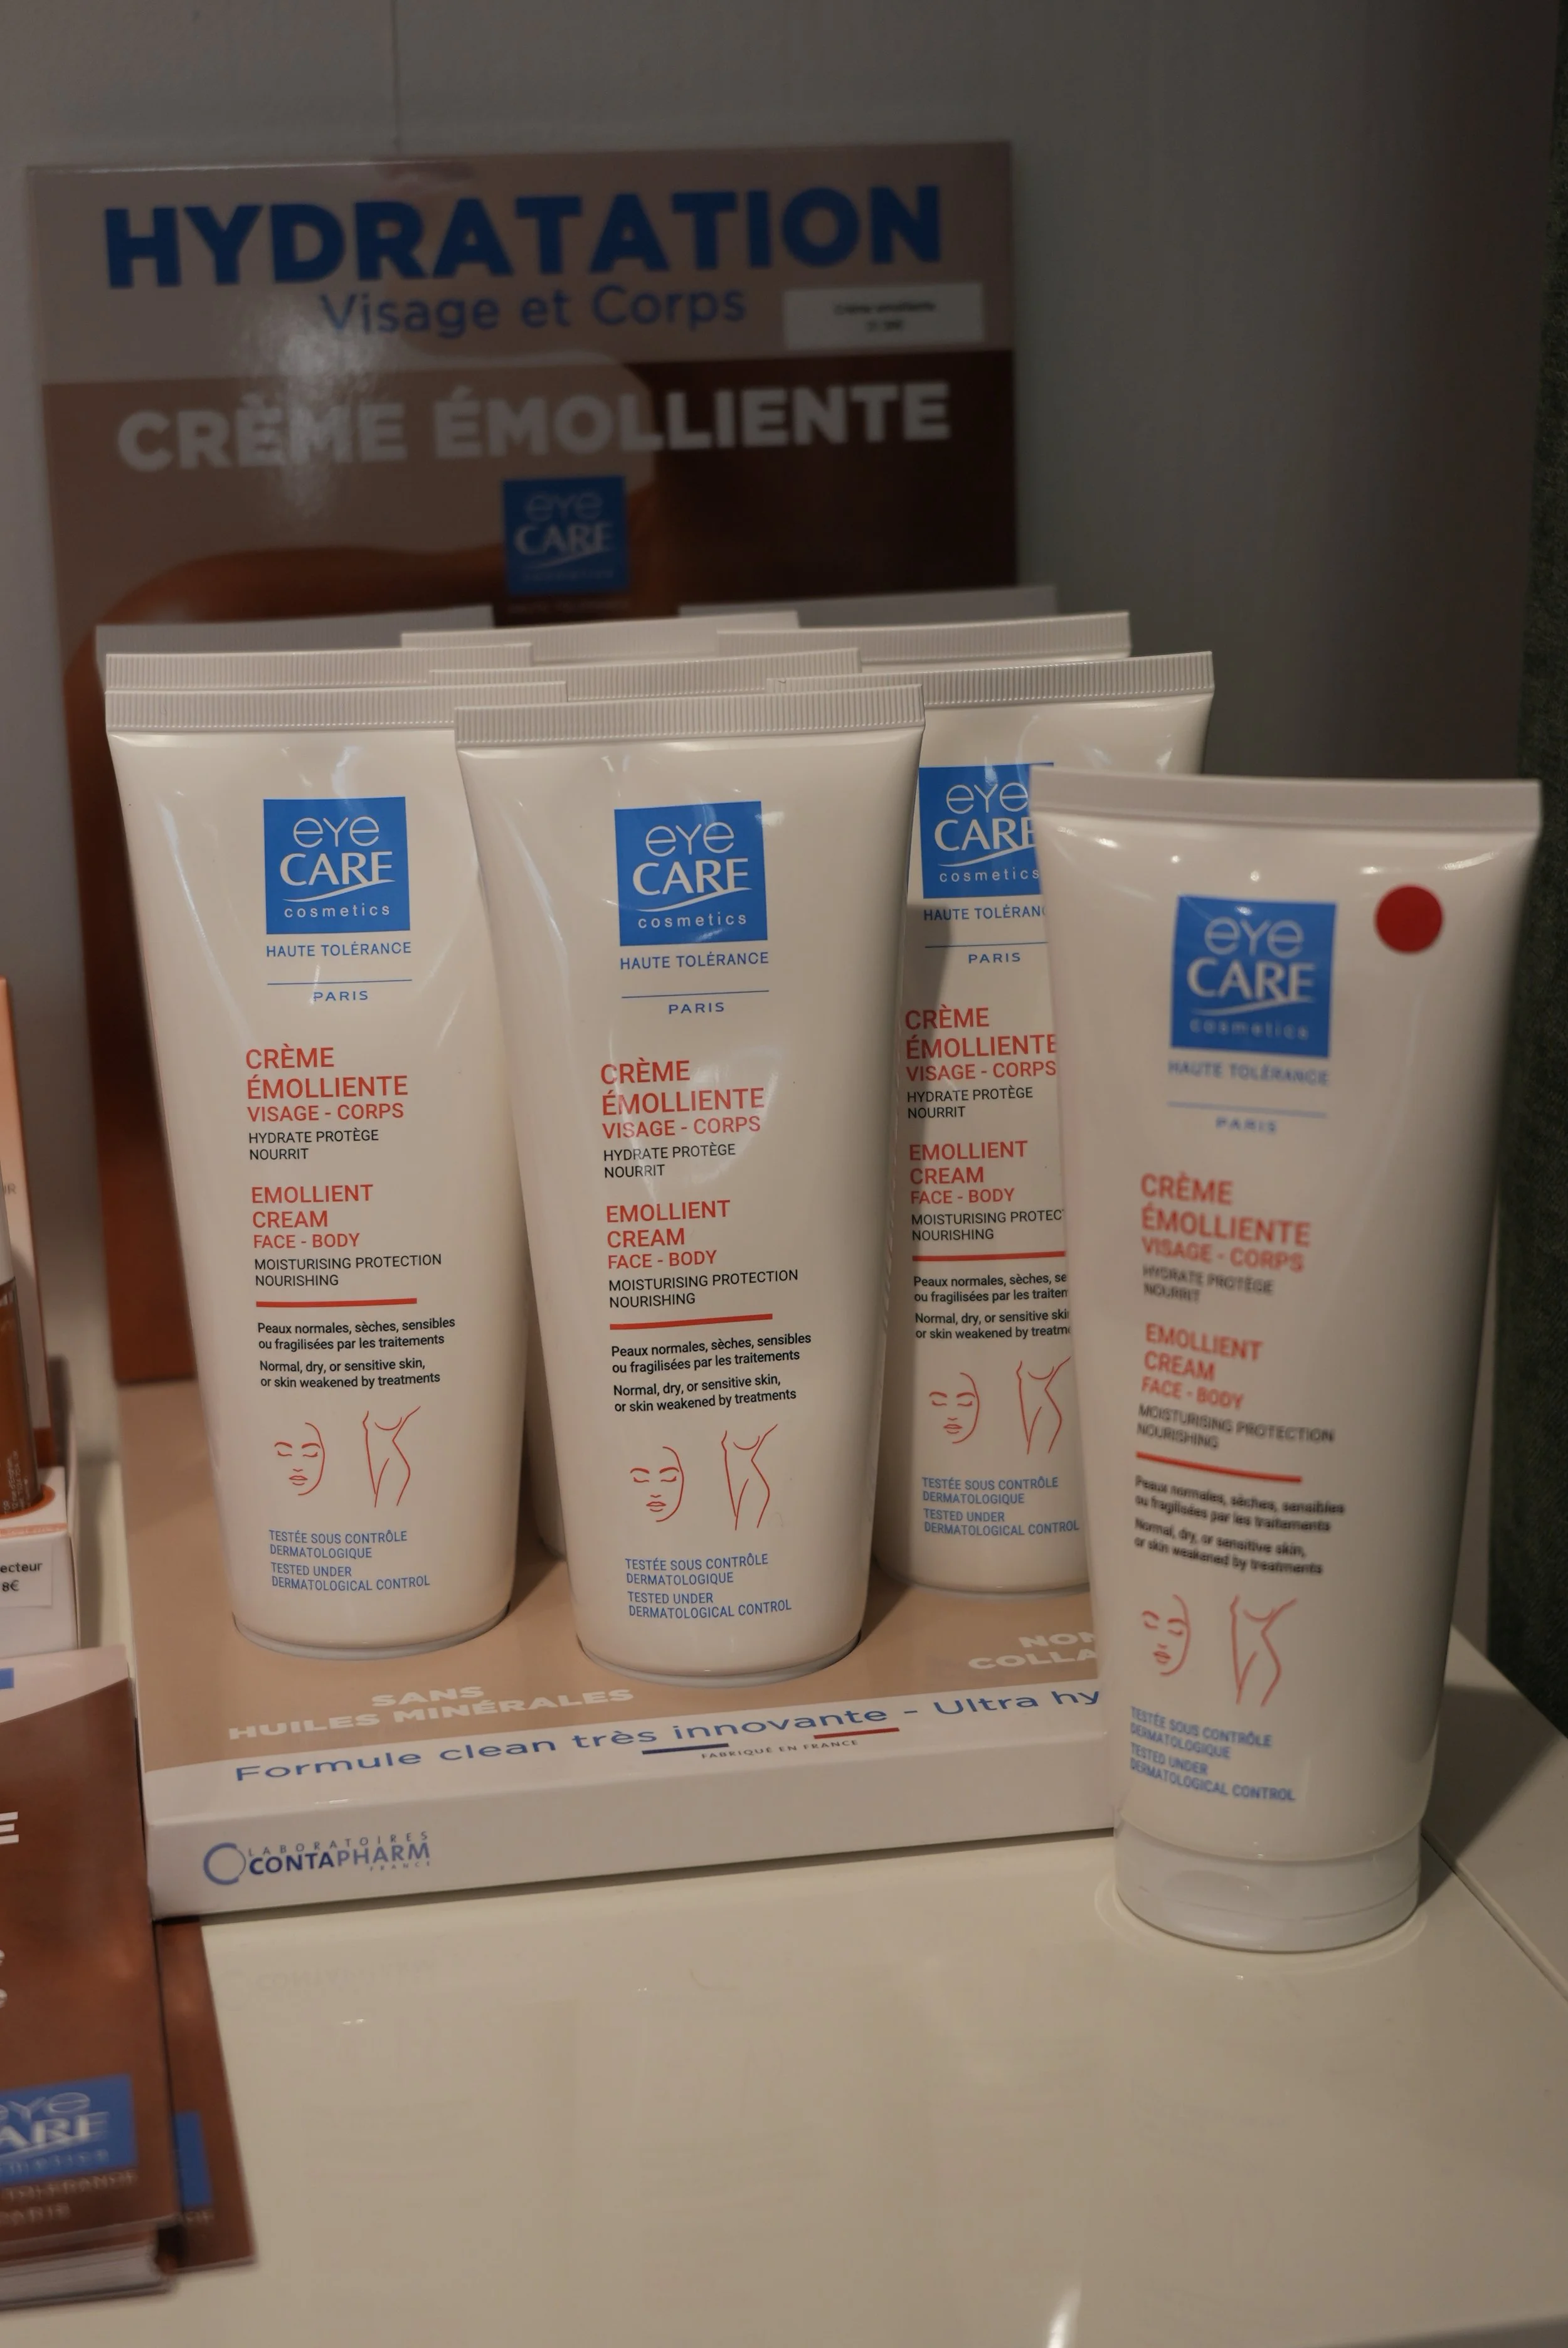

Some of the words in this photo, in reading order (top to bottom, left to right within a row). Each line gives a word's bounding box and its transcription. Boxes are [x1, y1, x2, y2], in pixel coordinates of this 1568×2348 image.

[105, 185, 941, 289] HYDRATATION
[321, 292, 499, 339] Visage
[521, 289, 571, 330] et
[592, 284, 747, 331] Corps
[117, 388, 407, 474] CRÈME
[434, 380, 951, 461] ÉMOLLIENTE
[526, 492, 603, 523] eye
[513, 521, 613, 557] CARE
[946, 782, 1030, 814] eye
[294, 817, 379, 847] eye
[646, 822, 734, 856] eye
[280, 851, 395, 886] CARE
[633, 858, 751, 896] CARE
[940, 868, 1041, 886] cosmetics
[285, 903, 389, 917] cosmetics
[638, 912, 746, 928] cosmetics
[924, 908, 972, 922] HAUTE
[1205, 916, 1303, 957] eye
[267, 945, 315, 957] HAUTE
[321, 942, 411, 956] TOLÉRANCE
[968, 953, 1020, 964] PARIS
[620, 957, 670, 970] HAUTE
[676, 952, 768, 967] TOLÉRANCE
[1187, 957, 1316, 1002] CARE
[314, 991, 368, 1001] PARIS
[669, 1002, 724, 1014] PARIS
[906, 1004, 989, 1031] CRÈME
[246, 1043, 334, 1069] CRÈME
[601, 1058, 690, 1086] CRÈME
[906, 1063, 975, 1081] VISAGE
[993, 1061, 1056, 1078] CORPS
[1168, 1060, 1222, 1078] HAUTE
[248, 1075, 408, 1099] ÉMOLLIENTE
[603, 1088, 763, 1115] ÉMOLLIENTE
[247, 1105, 319, 1122] VISAGE
[337, 1103, 403, 1120] CORPS
[602, 1120, 675, 1139] VISAGE
[694, 1116, 760, 1134] CORPS
[1216, 1117, 1276, 1133] PARIS
[249, 1132, 312, 1144] HYDRATE
[317, 1128, 379, 1142] PROTÈGE
[250, 1148, 309, 1160] NOURRIT
[604, 1147, 668, 1161] HYDRATE
[673, 1142, 735, 1158] PROTÈGE
[910, 1140, 1028, 1160] EMOLLIENT
[605, 1164, 665, 1178] NOURRIT
[911, 1166, 983, 1184] CREAM
[252, 1184, 373, 1203] EMOLLIENT
[911, 1191, 952, 1208] FACE
[969, 1188, 1014, 1203] BODY
[1141, 1172, 1232, 1205] CRÈME
[253, 1211, 327, 1228] CREAM
[607, 1200, 730, 1223] EMOLLIENT
[1142, 1201, 1312, 1247] ÉMOLLIENTE
[254, 1235, 295, 1248] FACE
[313, 1233, 359, 1248] BODY
[608, 1228, 684, 1248] CREAM
[255, 1258, 351, 1270] MOISTURISING
[356, 1254, 441, 1268] PROTECTION
[608, 1254, 652, 1269] FACE
[669, 1250, 717, 1266] BODY
[1142, 1236, 1210, 1262] VISAGE
[1231, 1248, 1305, 1273] CORPS
[256, 1275, 338, 1286] NOURISHING
[609, 1275, 707, 1291] MOISTURISING
[712, 1269, 797, 1285] PROTECTION
[610, 1293, 695, 1308] NOURISHING
[258, 1323, 292, 1334] Peaux
[295, 1322, 351, 1335] normales,
[355, 1321, 398, 1333] sèches,
[402, 1317, 455, 1331] sensibles
[259, 1341, 272, 1349] ou
[275, 1339, 334, 1352] fragilisées
[337, 1341, 356, 1352] par
[359, 1337, 376, 1348] les
[379, 1335, 444, 1347] traitements
[612, 1346, 648, 1356] Peaux
[652, 1341, 707, 1355] normales,
[711, 1337, 754, 1350] sèches,
[758, 1333, 811, 1346] sensibles
[1146, 1323, 1263, 1361] EMOLLIENT
[260, 1361, 302, 1374] Normal,
[306, 1361, 326, 1374] dry,
[345, 1359, 396, 1371] sensitive
[399, 1357, 425, 1369] skin,
[630, 1359, 691, 1374] fragilisées
[694, 1359, 712, 1371] par
[716, 1355, 731, 1366] les
[734, 1351, 800, 1364] traitements
[1144, 1350, 1214, 1381] CREAM
[275, 1376, 296, 1387] skin
[300, 1376, 358, 1388] weakened
[362, 1376, 375, 1389] by
[378, 1373, 440, 1386] treatments
[614, 1383, 659, 1396] Normal,
[663, 1383, 683, 1396] dry,
[687, 1383, 698, 1391] or
[702, 1377, 751, 1390] sensitive
[755, 1374, 780, 1386] skin,
[630, 1400, 653, 1411] skin
[657, 1395, 715, 1410] weakened
[719, 1394, 732, 1408] by
[734, 1389, 796, 1404] treatments
[1142, 1376, 1181, 1398] FACE
[1197, 1388, 1244, 1409] BODY
[269, 1530, 307, 1543] TESTÉE
[311, 1534, 341, 1544] SOUS
[345, 1530, 407, 1544] CONTRÔLE
[270, 1544, 371, 1559] DERMATOLOGIQUE
[625, 1558, 666, 1570] TESTÉE
[670, 1559, 702, 1570] SOUS
[706, 1553, 768, 1569] CONTRÔLE
[271, 1562, 309, 1575] TESTED
[314, 1566, 351, 1576] UNDER
[627, 1572, 733, 1585] DERMATOLOGIQUE
[272, 1576, 373, 1591] DERMATOLOGICAL
[376, 1575, 430, 1590] CONTROL
[627, 1591, 669, 1603] TESTED
[674, 1593, 713, 1604] UNDER
[629, 1605, 734, 1618] DERMATOLOGICAL
[738, 1600, 792, 1615] CONTROL
[372, 1687, 484, 1706] SANS
[229, 1714, 379, 1740] HUILES
[393, 1687, 633, 1722] MINÉRALES
[236, 1753, 421, 1781] Formule
[440, 1737, 556, 1760] clean
[572, 1731, 657, 1748] très
[674, 1707, 888, 1739] innovante
[933, 1697, 1039, 1714] Ultra
[701, 1745, 774, 1760] FABRIQUÉ
[803, 1739, 859, 1751] FRANCE
[249, 1832, 430, 1857] LABORATOIRES
[249, 1841, 430, 1875] CONTAPHARM
